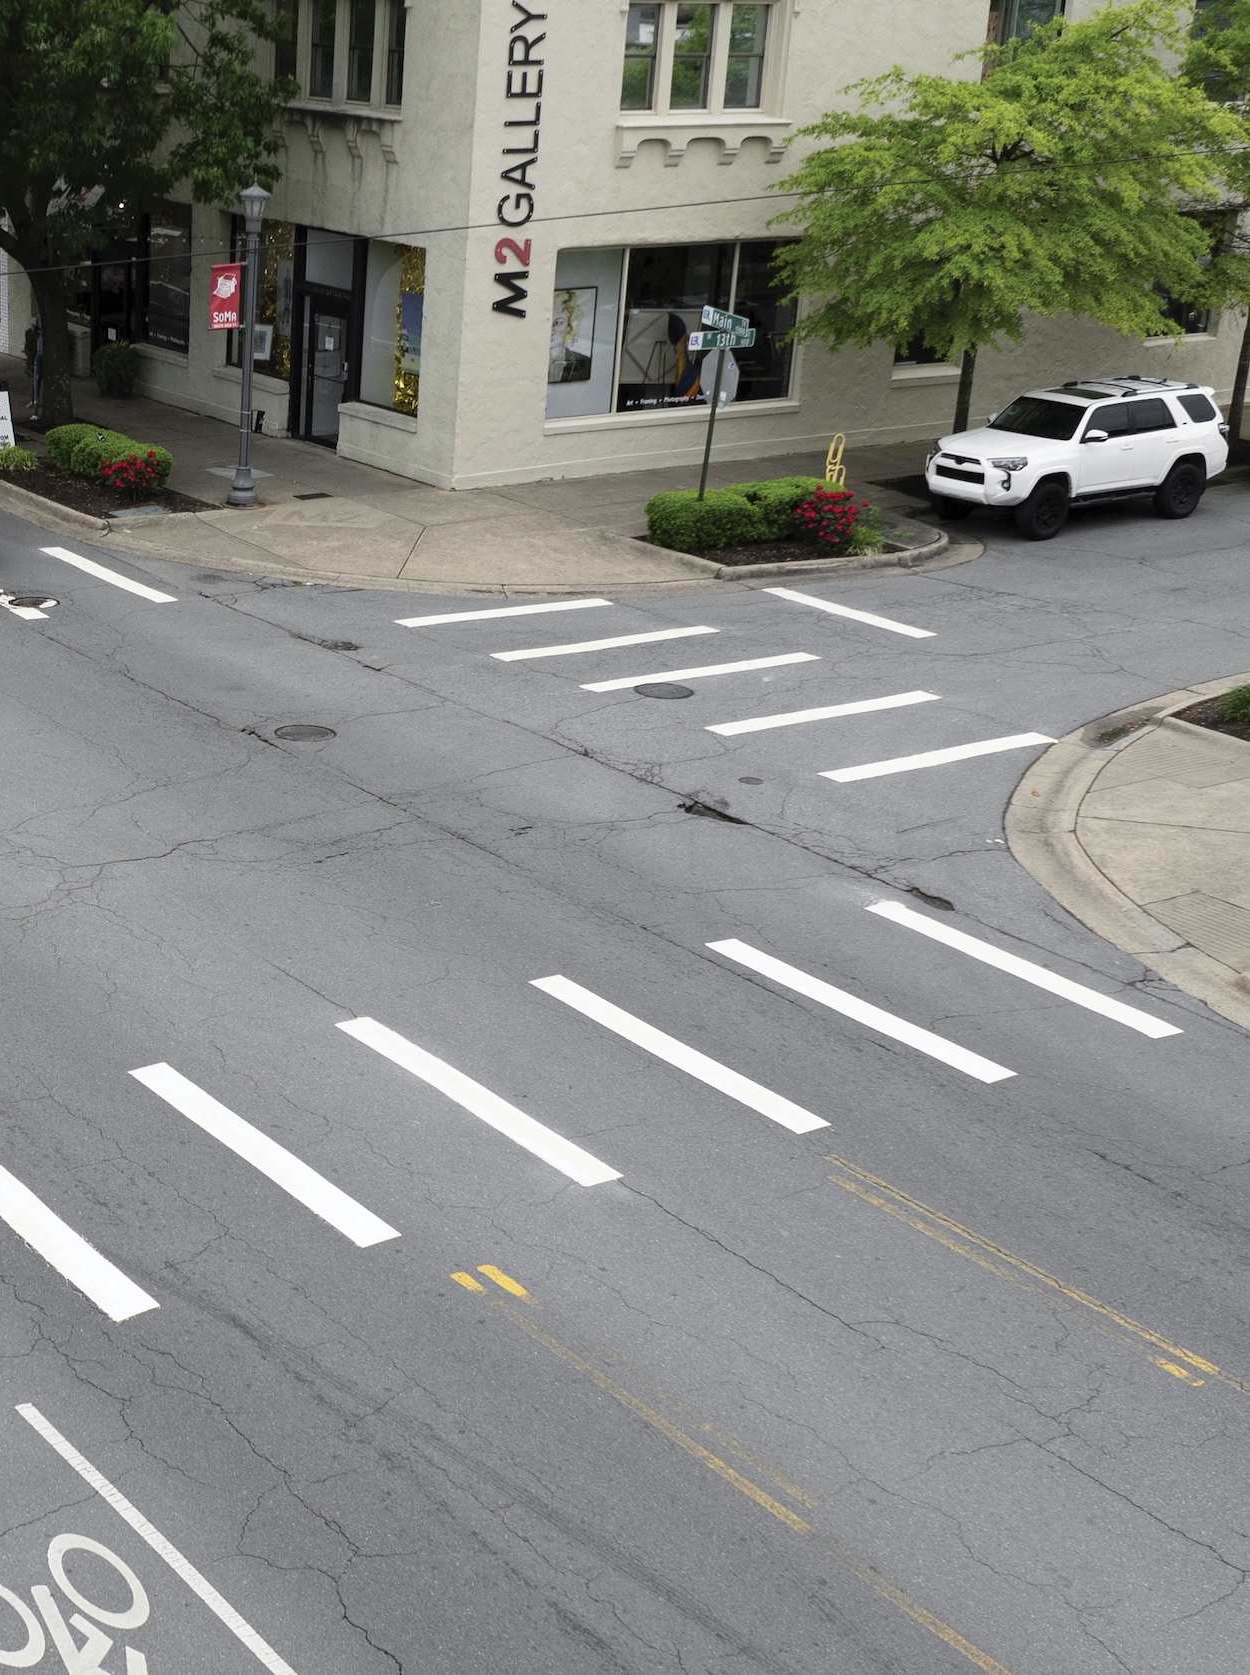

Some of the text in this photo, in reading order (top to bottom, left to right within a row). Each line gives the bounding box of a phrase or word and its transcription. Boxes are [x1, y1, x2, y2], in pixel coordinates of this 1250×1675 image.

[492, 0, 548, 318] M2 GALLERY
[712, 311, 733, 330] Main
[716, 333, 737, 347] 13th
[640, 397, 657, 405] Framing
[663, 395, 689, 404] Photography
